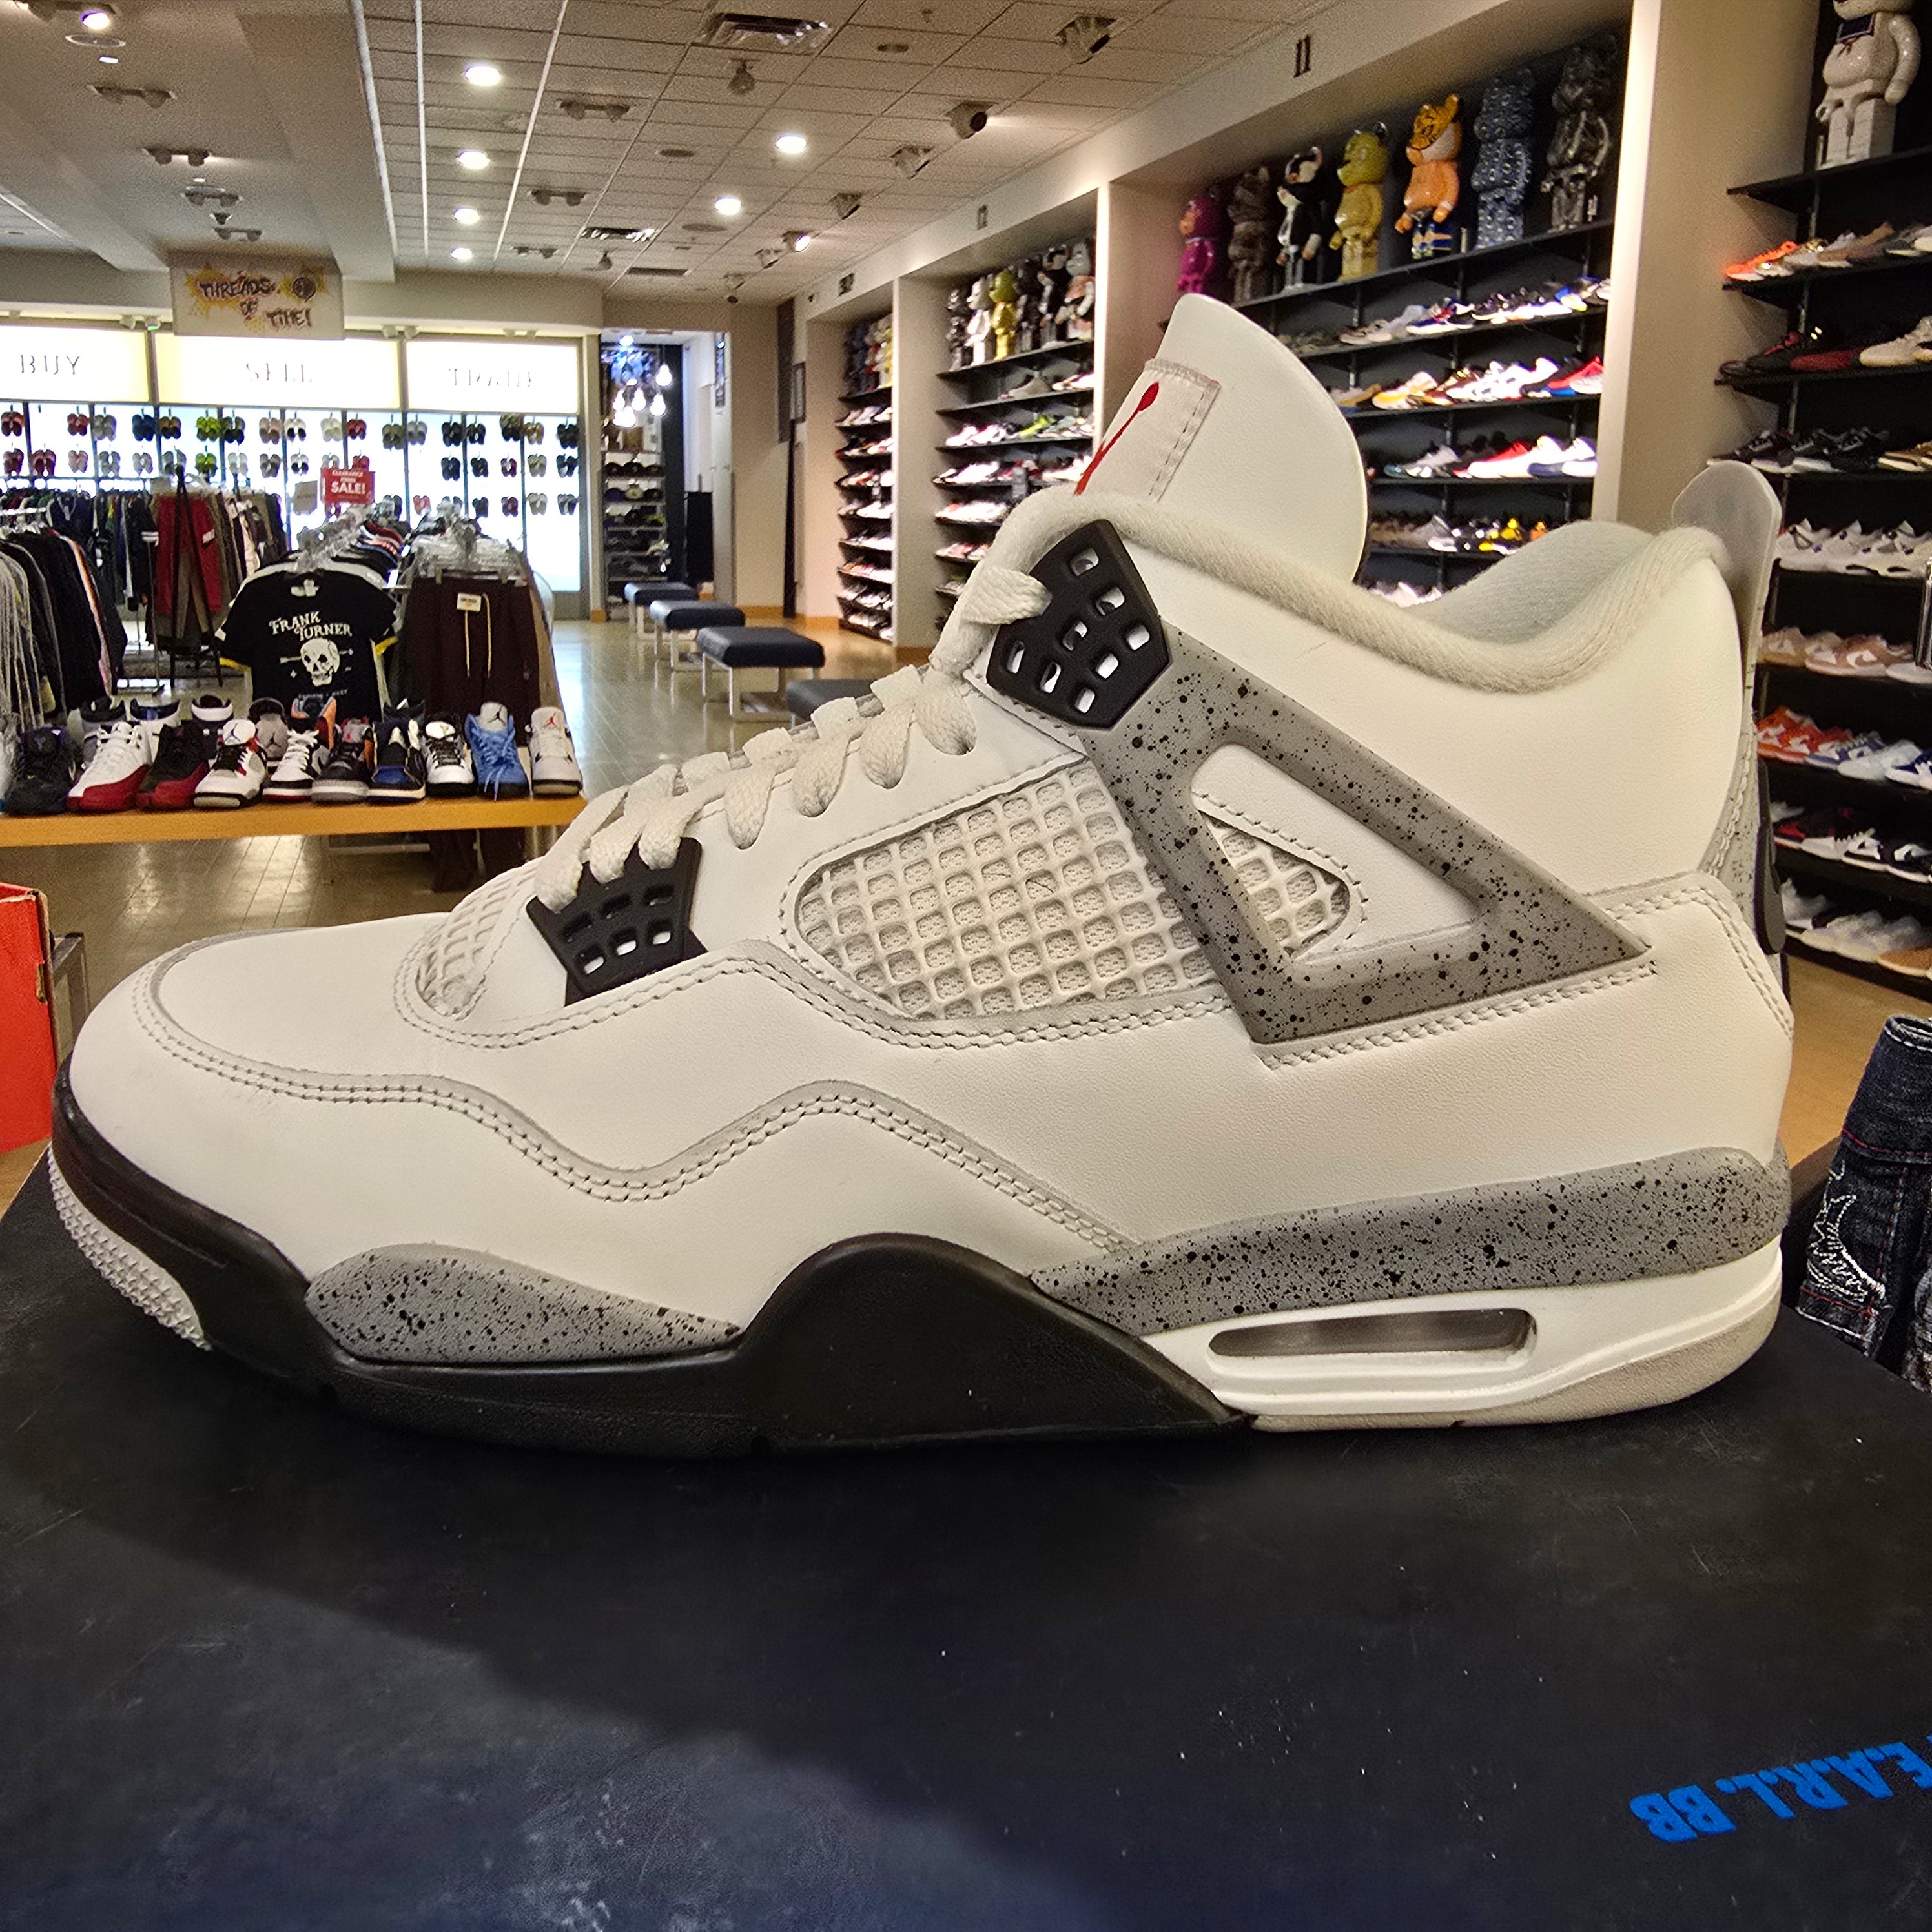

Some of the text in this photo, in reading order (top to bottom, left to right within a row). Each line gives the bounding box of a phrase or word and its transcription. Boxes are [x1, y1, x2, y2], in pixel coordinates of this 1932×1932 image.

[21, 354, 80, 375] BUY
[331, 481, 366, 495] SALE!
[269, 611, 321, 635] FRANK
[294, 623, 353, 641] TURNER
[1629, 1785, 1736, 1843] BB
